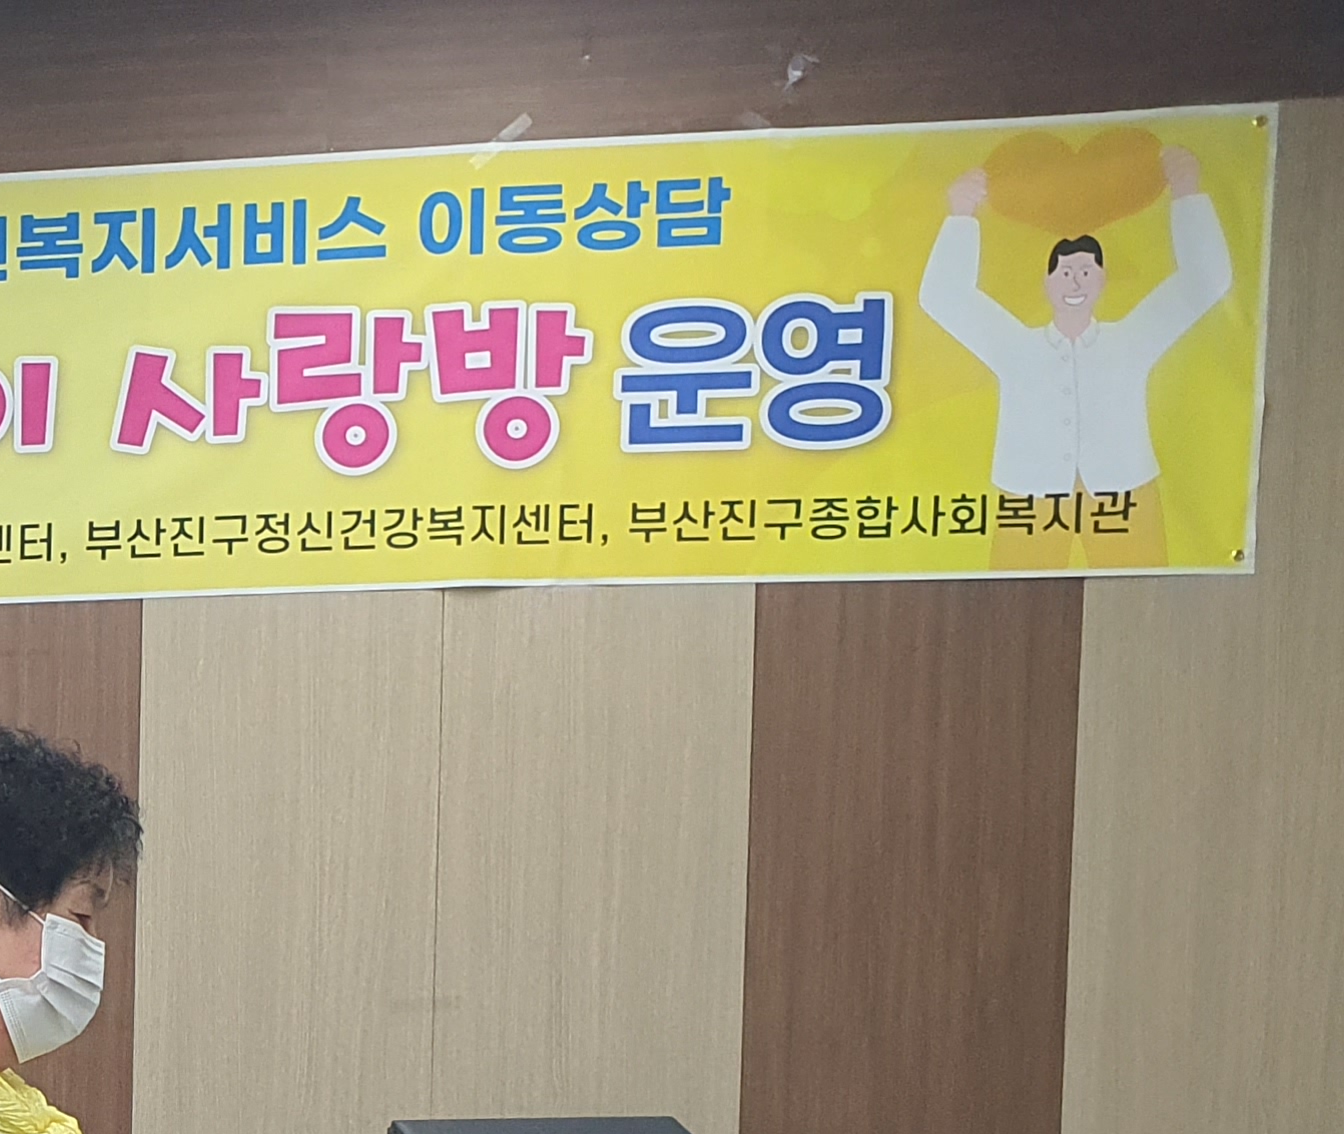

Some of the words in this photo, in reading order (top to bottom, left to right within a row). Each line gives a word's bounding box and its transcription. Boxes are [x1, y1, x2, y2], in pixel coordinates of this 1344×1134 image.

[418, 176, 733, 256] 이동상담
[115, 307, 588, 470] 사랑방
[620, 296, 888, 447] 운영
[84, 501, 611, 562] 부산진구정신건강복지센터,
[627, 490, 1137, 543] 부산진구종합사회복지관
